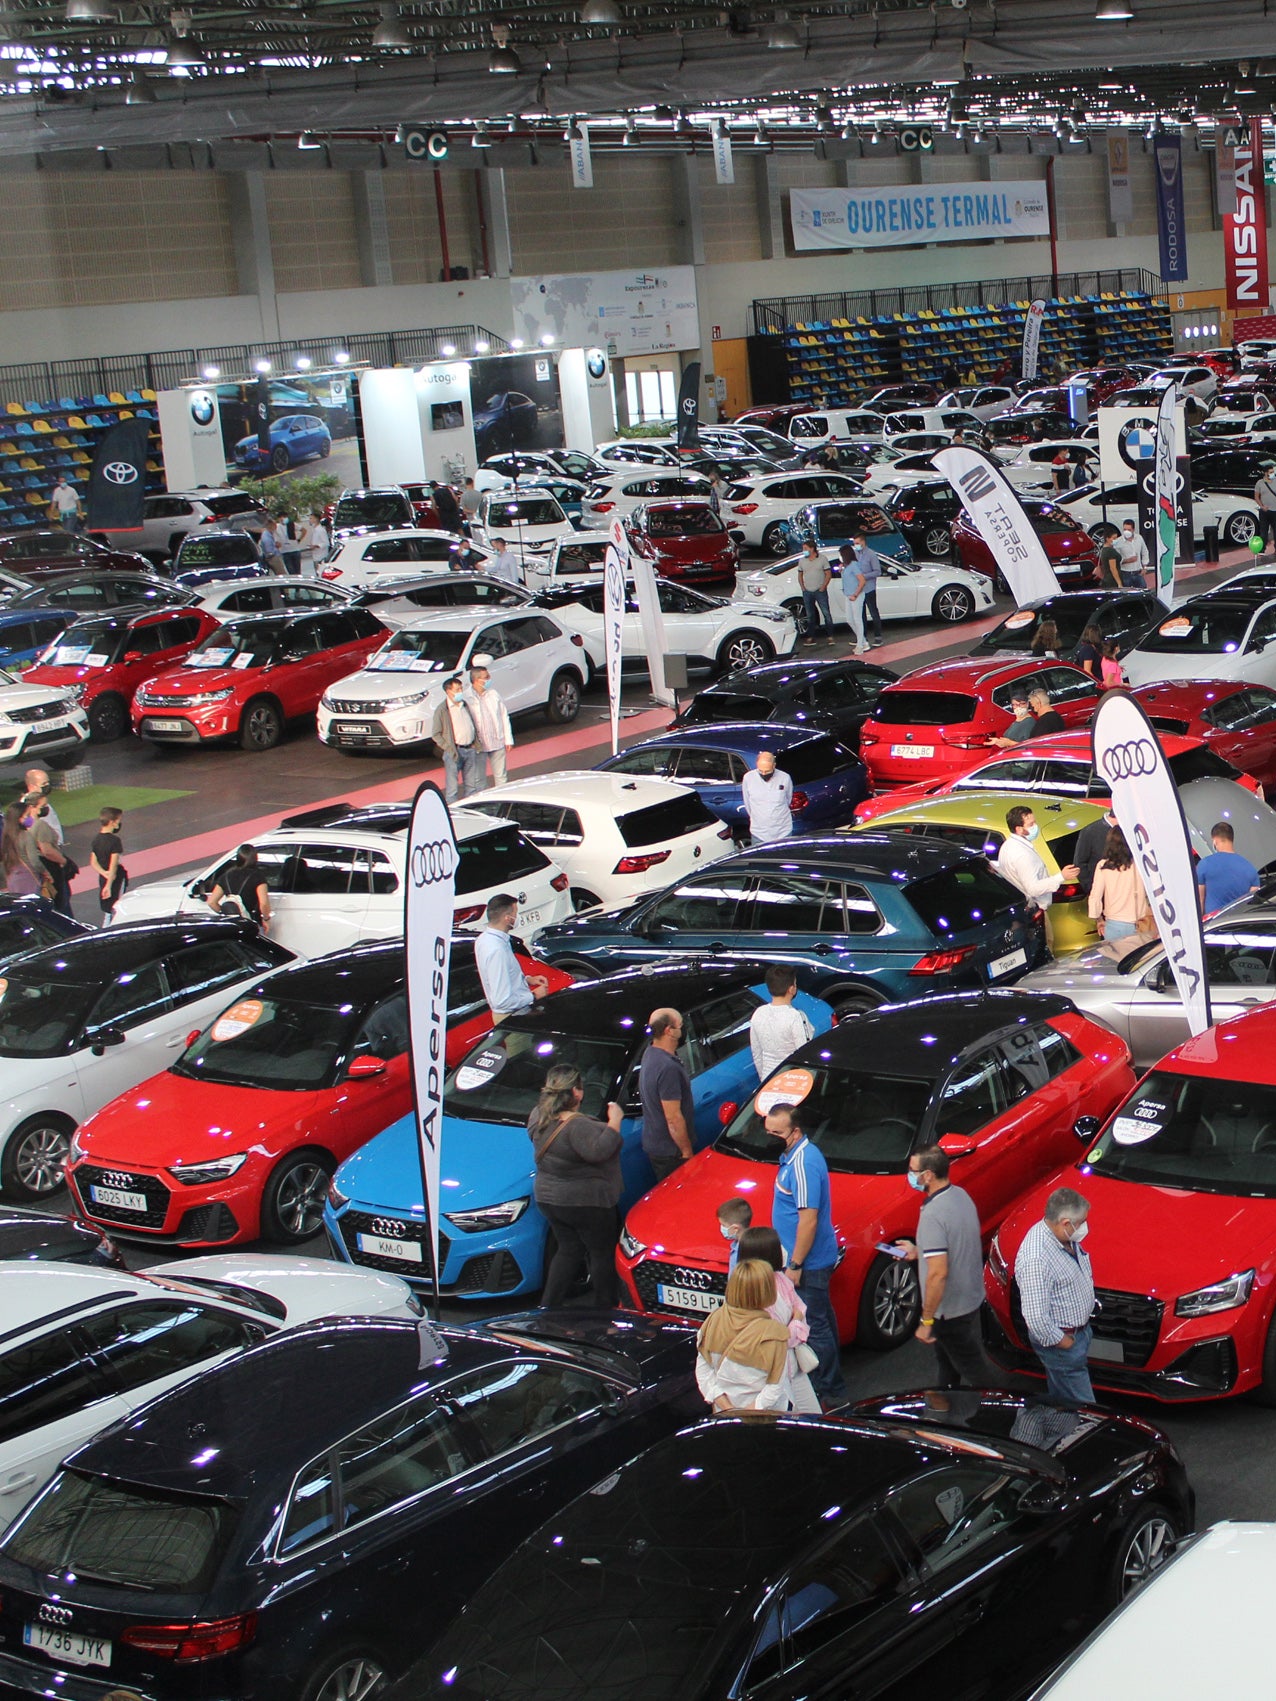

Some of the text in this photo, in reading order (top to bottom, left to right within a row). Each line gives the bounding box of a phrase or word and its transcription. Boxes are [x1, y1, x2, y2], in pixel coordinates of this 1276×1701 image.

[406, 132, 426, 157] C
[428, 132, 447, 158] C
[901, 130, 918, 150] C
[919, 128, 933, 149] C
[1224, 128, 1240, 146] A
[1240, 129, 1250, 145] A
[847, 193, 1012, 235] OURENSE TERMAL
[1166, 197, 1178, 272] RODOSA
[424, 373, 458, 386] utoga
[525, 911, 541, 923] KFB
[998, 958, 1017, 971] Tiguan
[240, 1003, 260, 1011] Apersa
[423, 934, 446, 1152] Apersa
[481, 1050, 502, 1060] Apersa
[783, 1072, 808, 1081] Apersa
[1138, 1099, 1166, 1110] Apersa
[98, 1188, 142, 1208] 6025 LKY
[379, 1241, 403, 1256] KM-0
[667, 1288, 699, 1307] 5159
[38, 1628, 105, 1661] 1736 JYK
